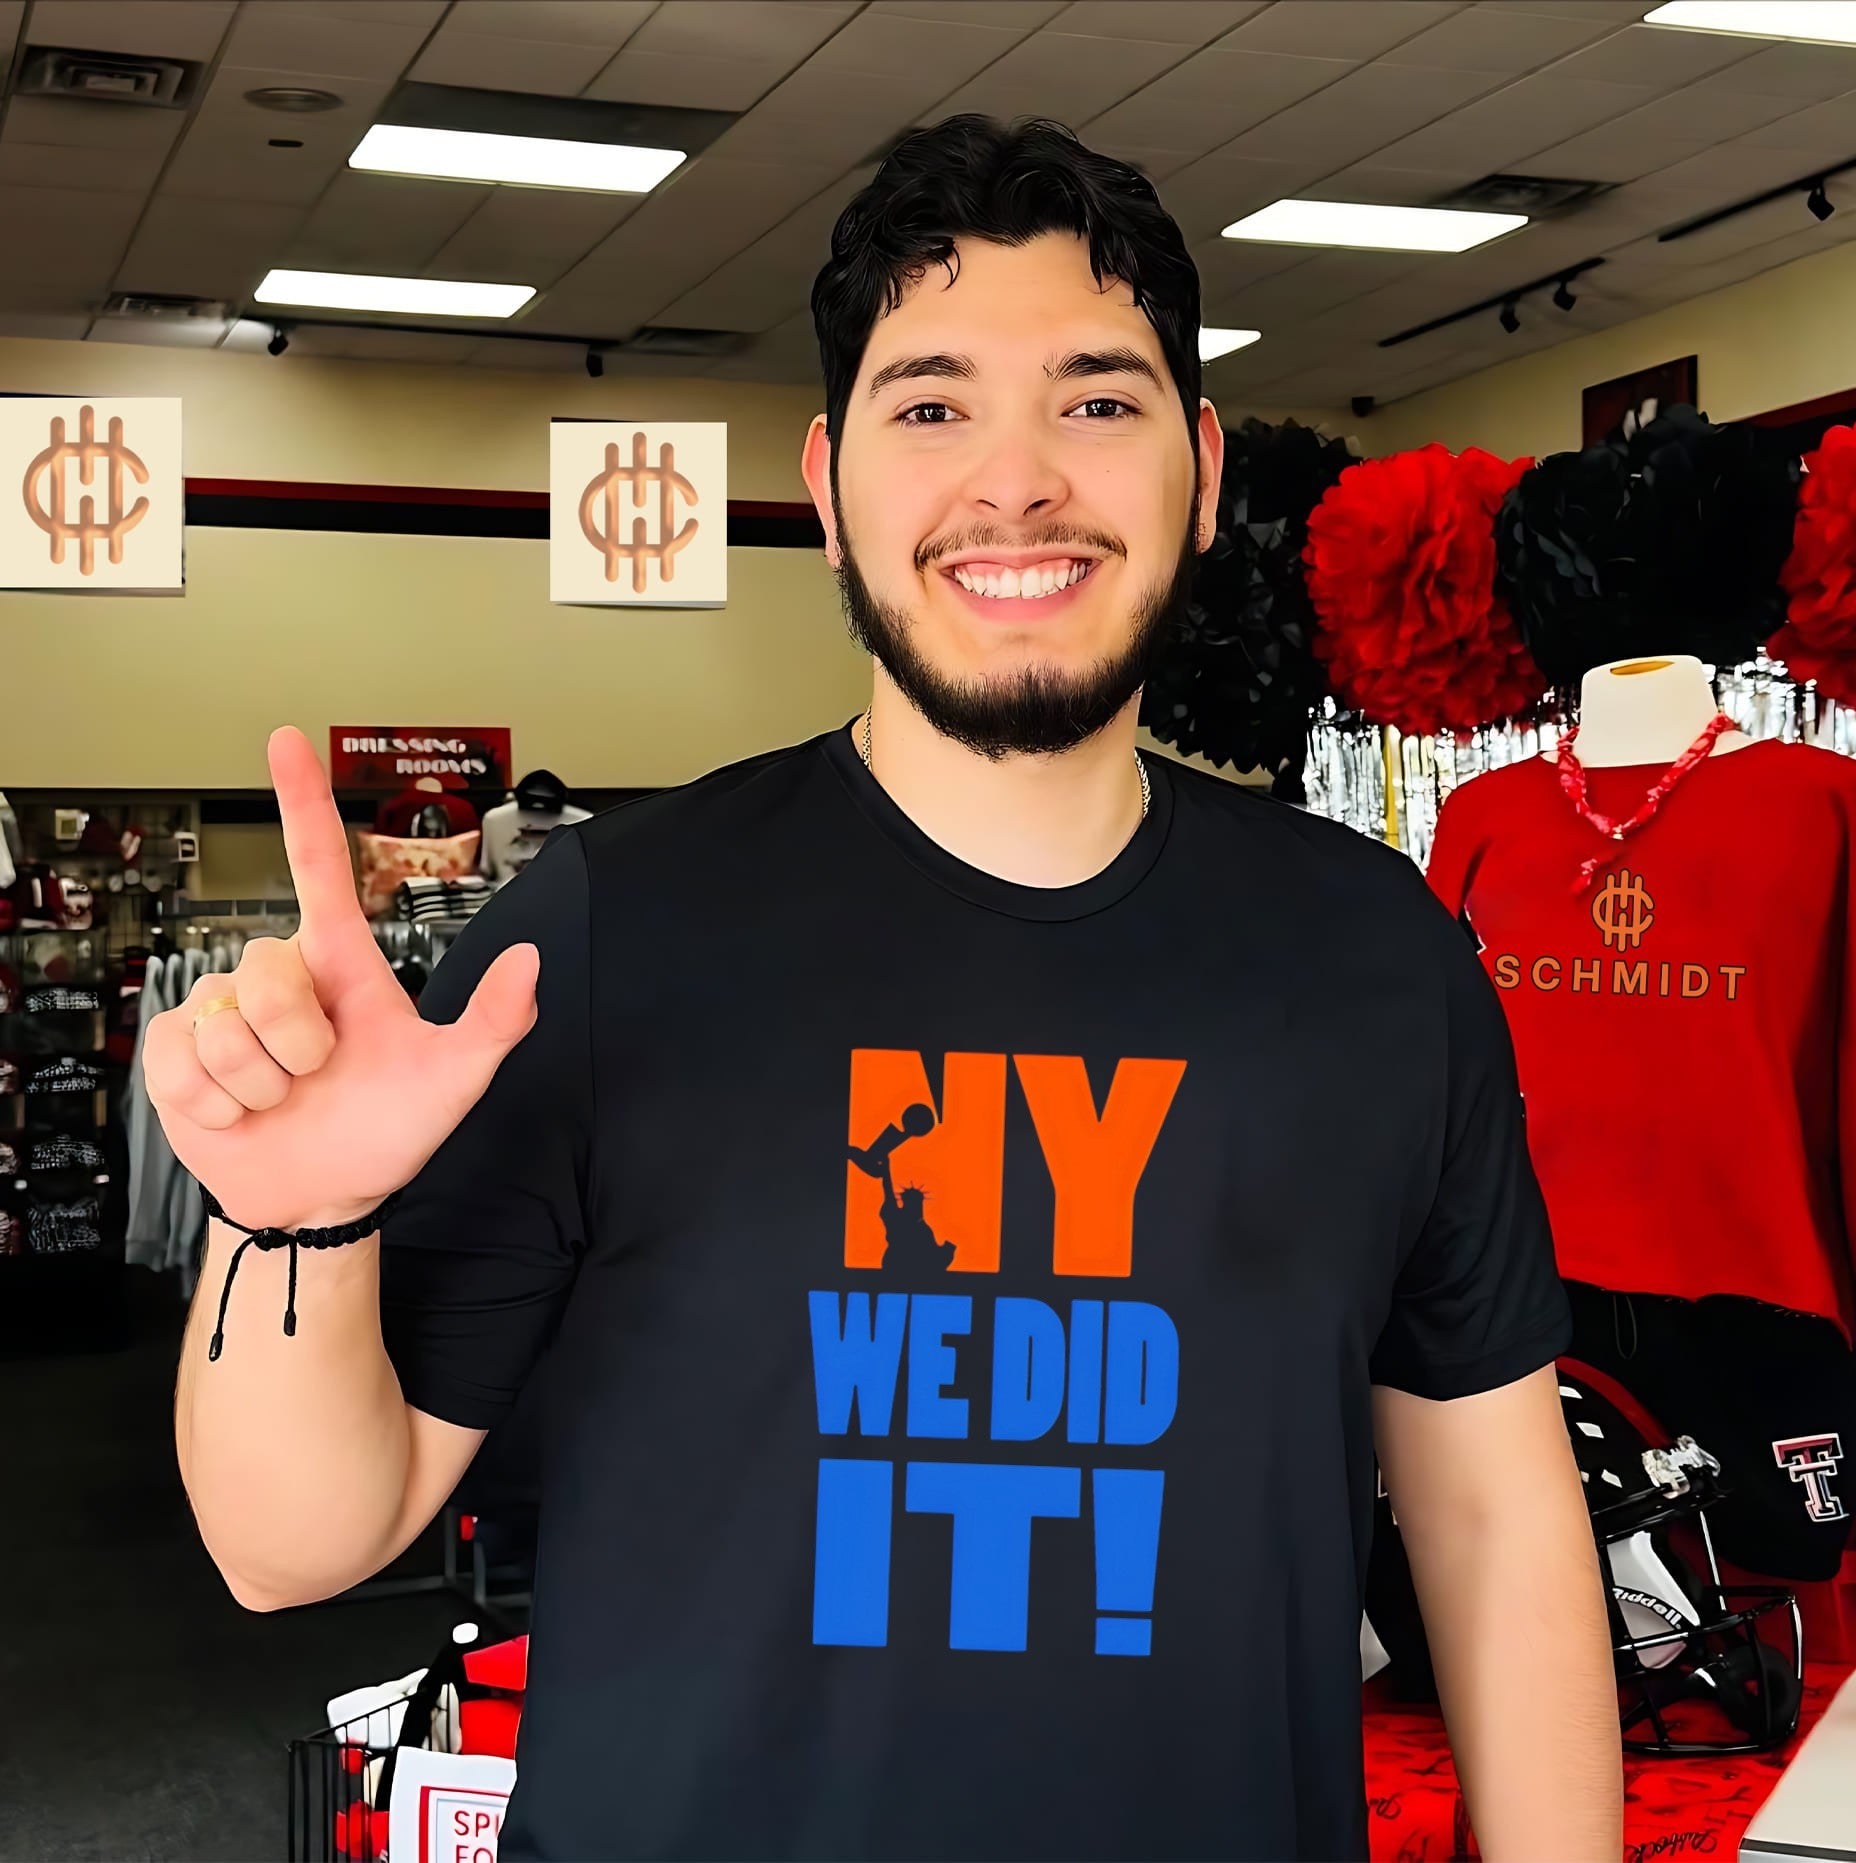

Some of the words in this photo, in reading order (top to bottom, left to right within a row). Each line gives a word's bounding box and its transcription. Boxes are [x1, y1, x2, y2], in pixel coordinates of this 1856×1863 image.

[342, 737, 467, 753] DRESSING
[396, 758, 487, 775] ROOMS
[1494, 954, 1747, 1000] SCHMIDT
[844, 1048, 1187, 1277] NY
[808, 1291, 973, 1439] WE
[991, 1297, 1180, 1445] DID
[812, 1458, 1166, 1656] IT!
